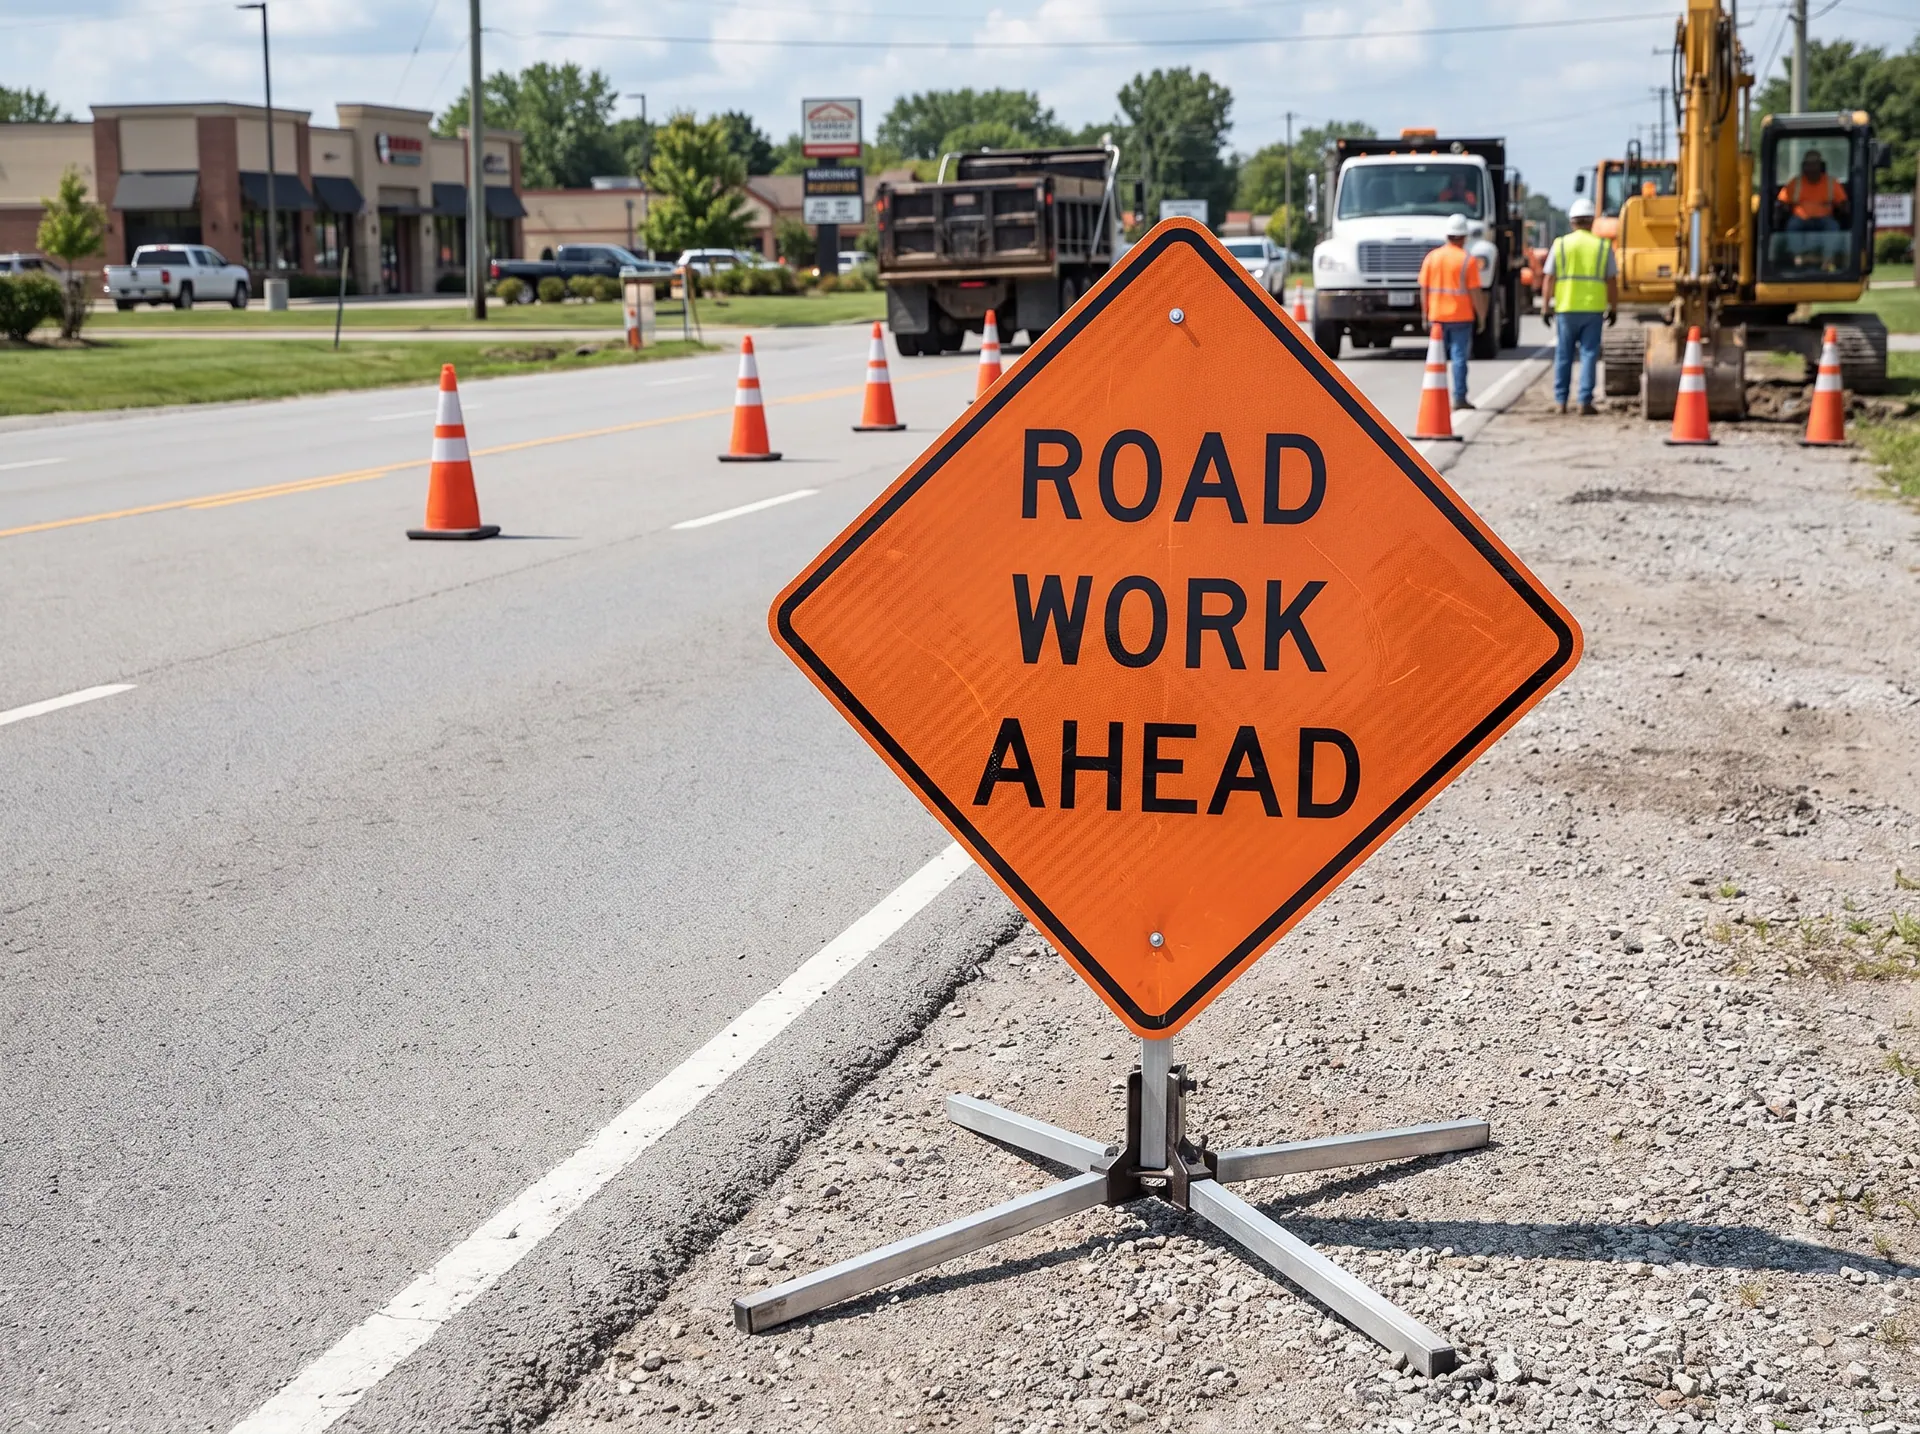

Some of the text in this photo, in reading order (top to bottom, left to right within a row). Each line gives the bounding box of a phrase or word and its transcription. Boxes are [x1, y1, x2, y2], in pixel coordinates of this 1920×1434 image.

[1021, 428, 1327, 525] ROAD
[1012, 573, 1328, 673] WORK
[972, 717, 1361, 819] AHEAD
